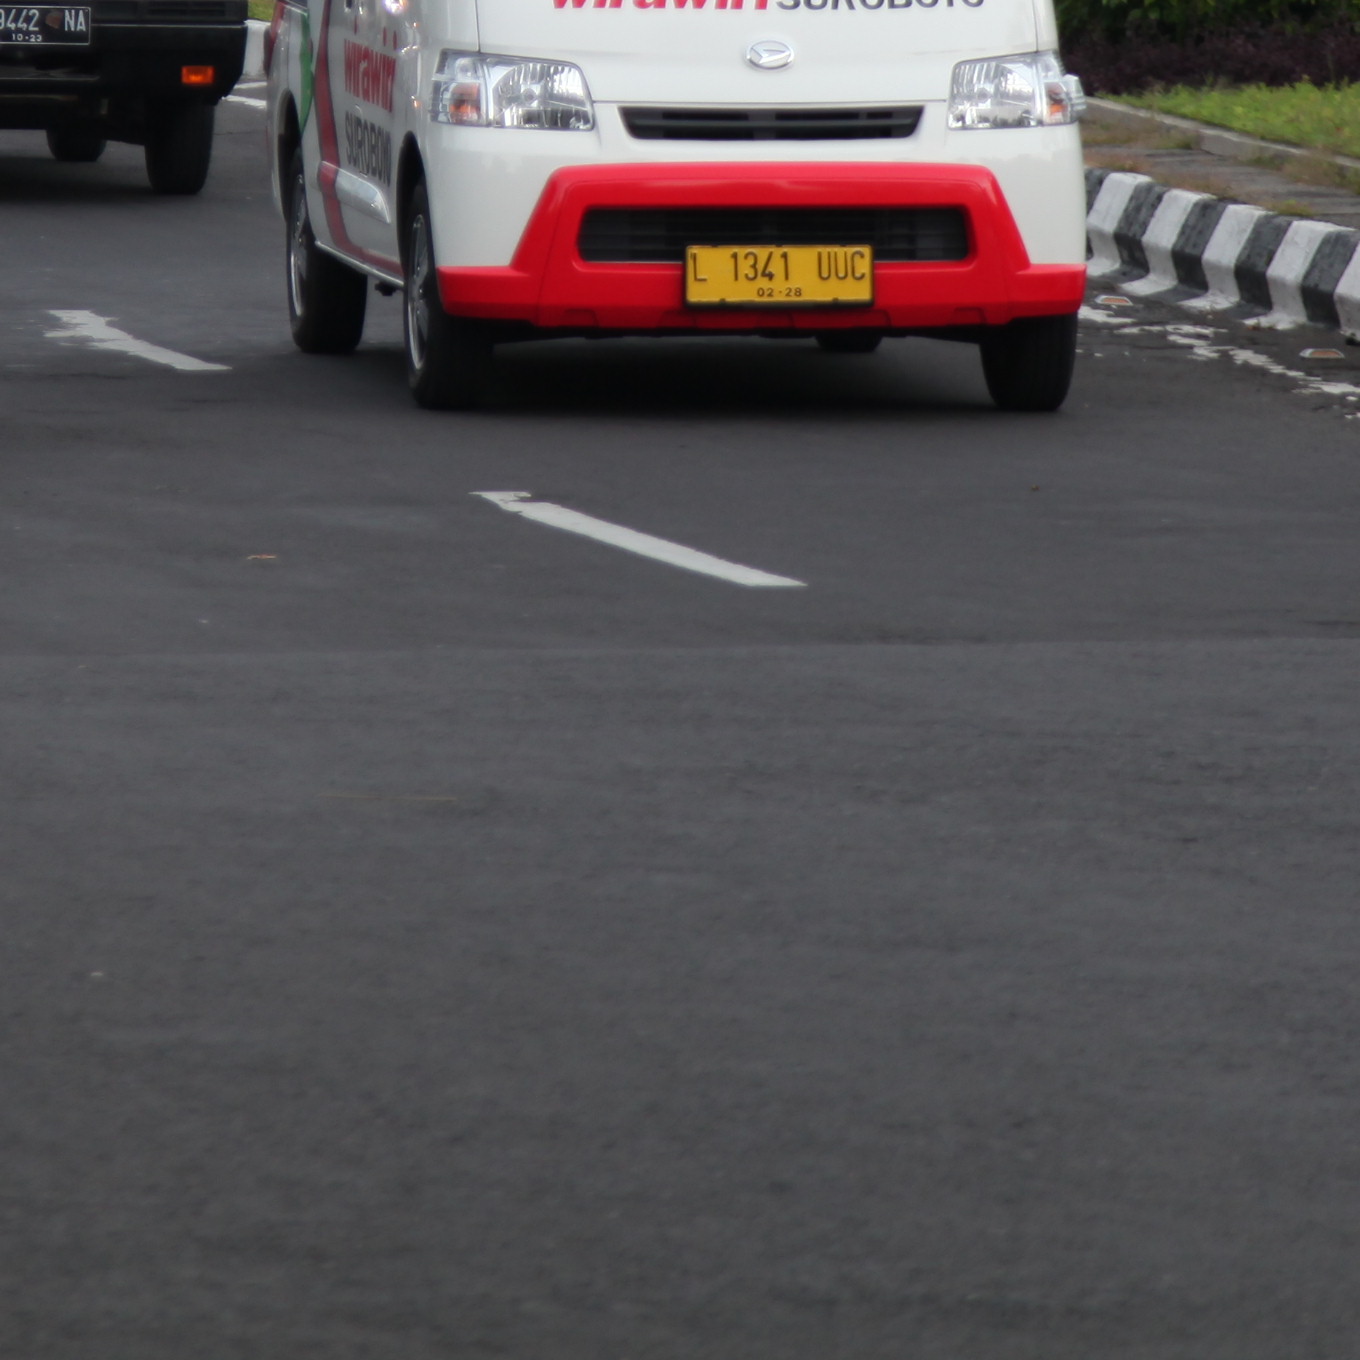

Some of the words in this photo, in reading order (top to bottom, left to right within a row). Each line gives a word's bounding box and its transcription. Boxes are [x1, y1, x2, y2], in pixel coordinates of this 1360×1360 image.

[64, 9, 87, 32] NA
[691, 252, 708, 282] L
[730, 251, 790, 282] 1341
[817, 250, 866, 281] UUC
